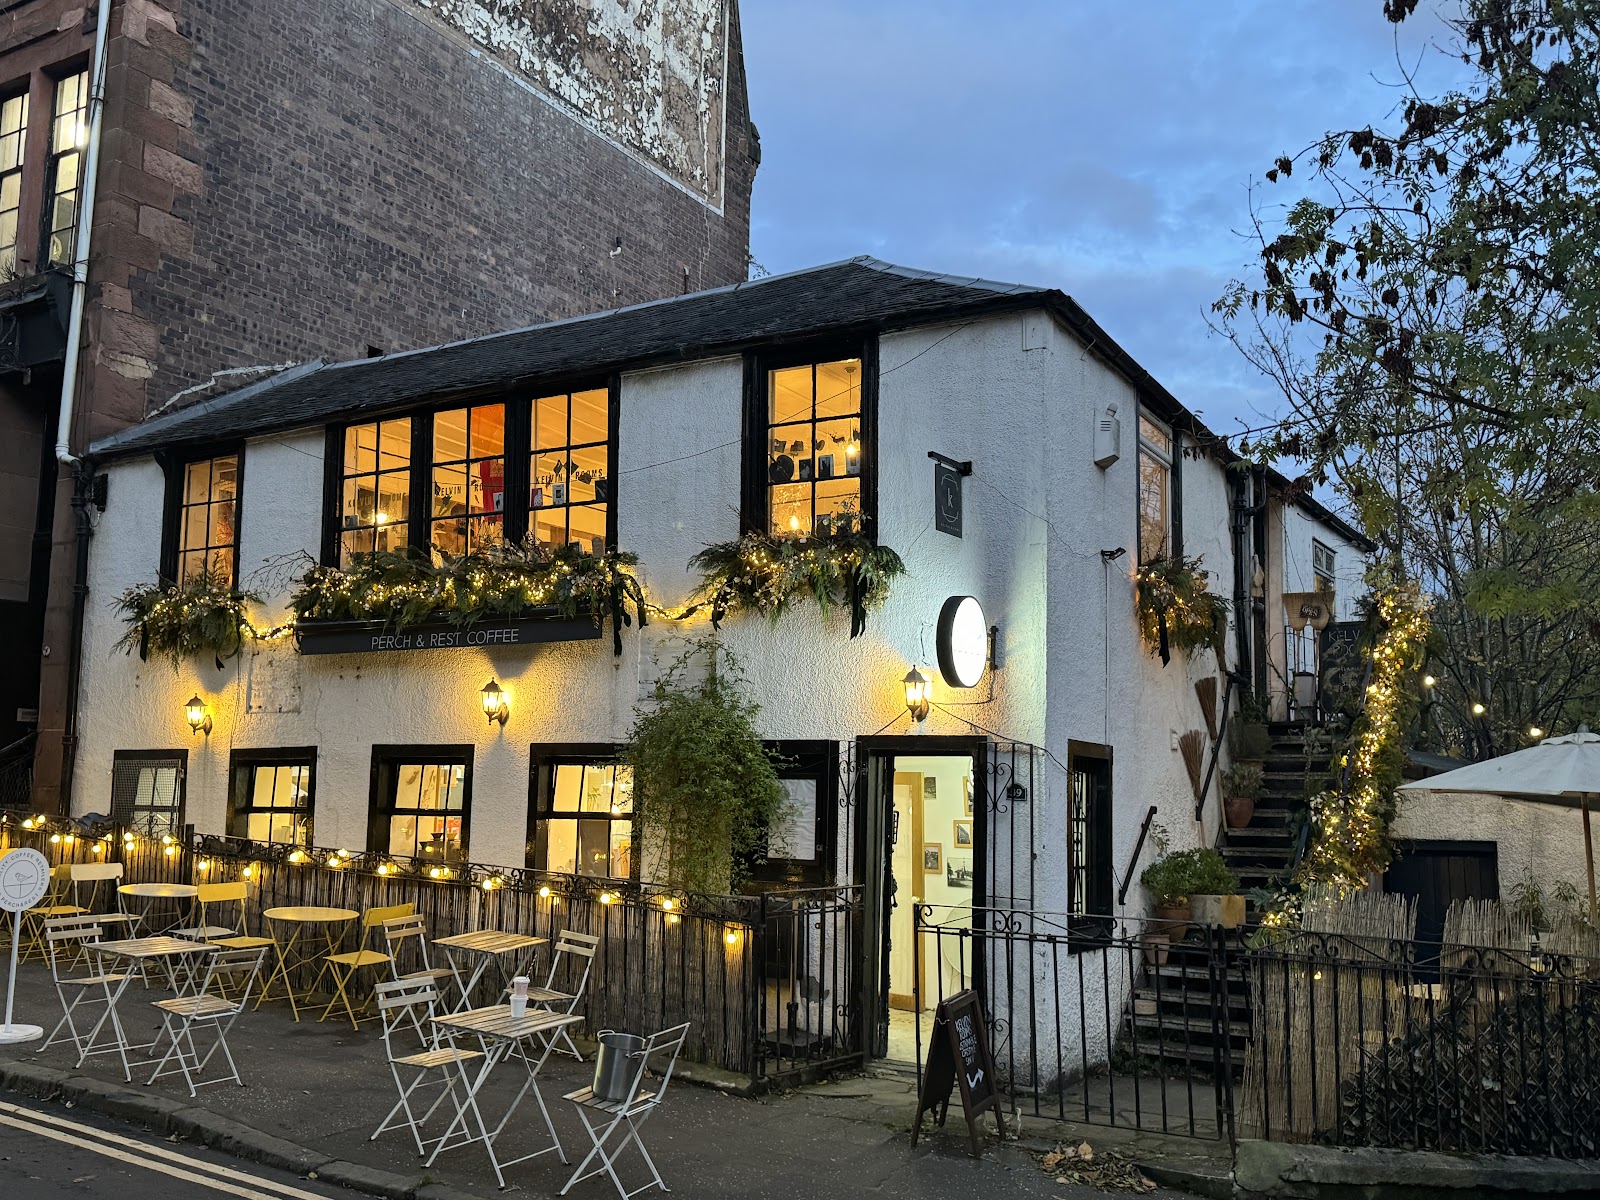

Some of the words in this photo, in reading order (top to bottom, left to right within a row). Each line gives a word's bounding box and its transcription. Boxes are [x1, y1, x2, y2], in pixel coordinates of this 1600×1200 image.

[371, 634, 411, 649] PERCH
[416, 634, 425, 647] &
[430, 631, 461, 647] REST
[467, 628, 519, 645] COFFEE
[1328, 629, 1361, 642] KELV
[10, 852, 35, 861] COFFEE
